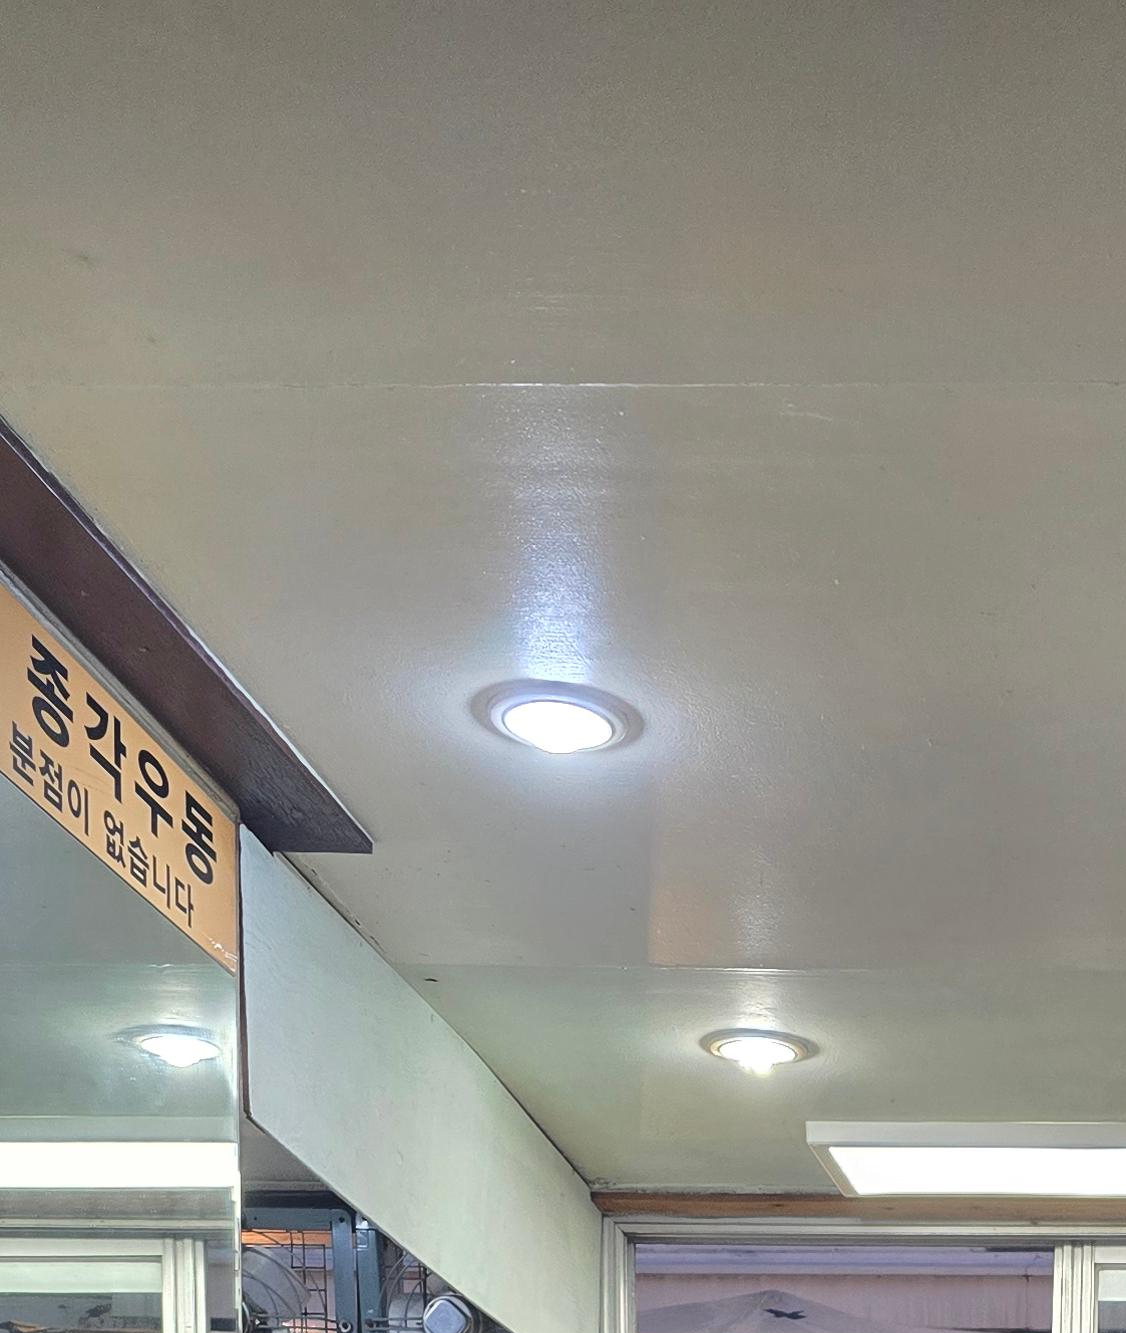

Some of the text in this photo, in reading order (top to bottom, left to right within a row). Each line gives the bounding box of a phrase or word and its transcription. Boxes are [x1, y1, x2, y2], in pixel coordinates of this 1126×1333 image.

[8, 720, 195, 929] 분점이 없습니다
[26, 634, 218, 885] 종각우동
